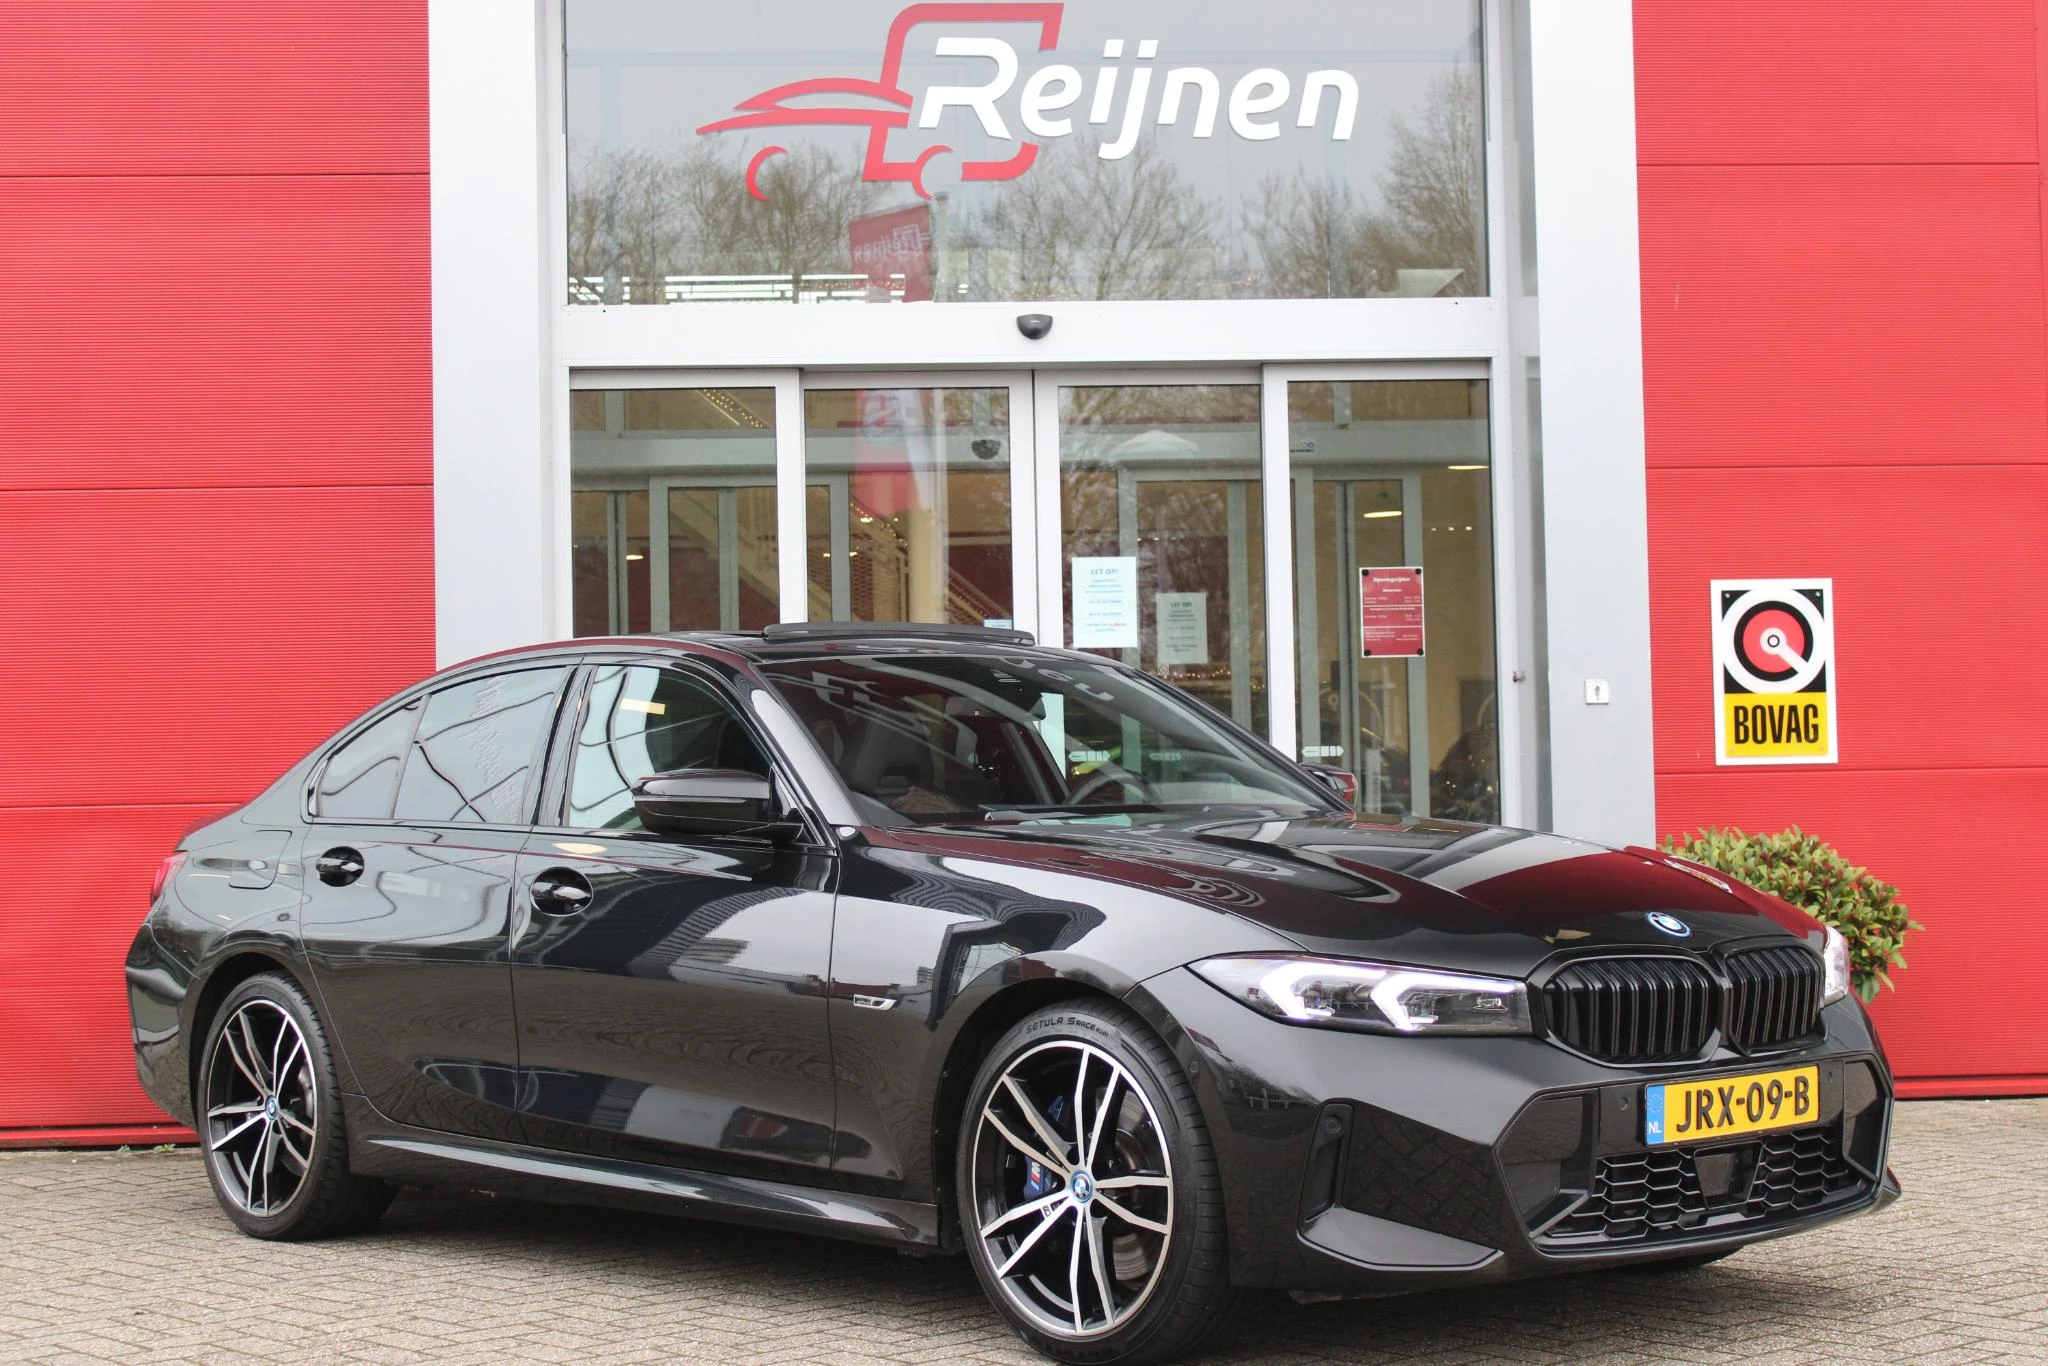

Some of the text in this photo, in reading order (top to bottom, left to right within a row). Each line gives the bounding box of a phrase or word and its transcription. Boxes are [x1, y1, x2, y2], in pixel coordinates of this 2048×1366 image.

[918, 37, 1360, 159] Reijnen
[1734, 703, 1819, 745] BOVAG
[1648, 1121, 1662, 1134] NL
[1676, 1075, 1810, 1133] JRX-09-B
